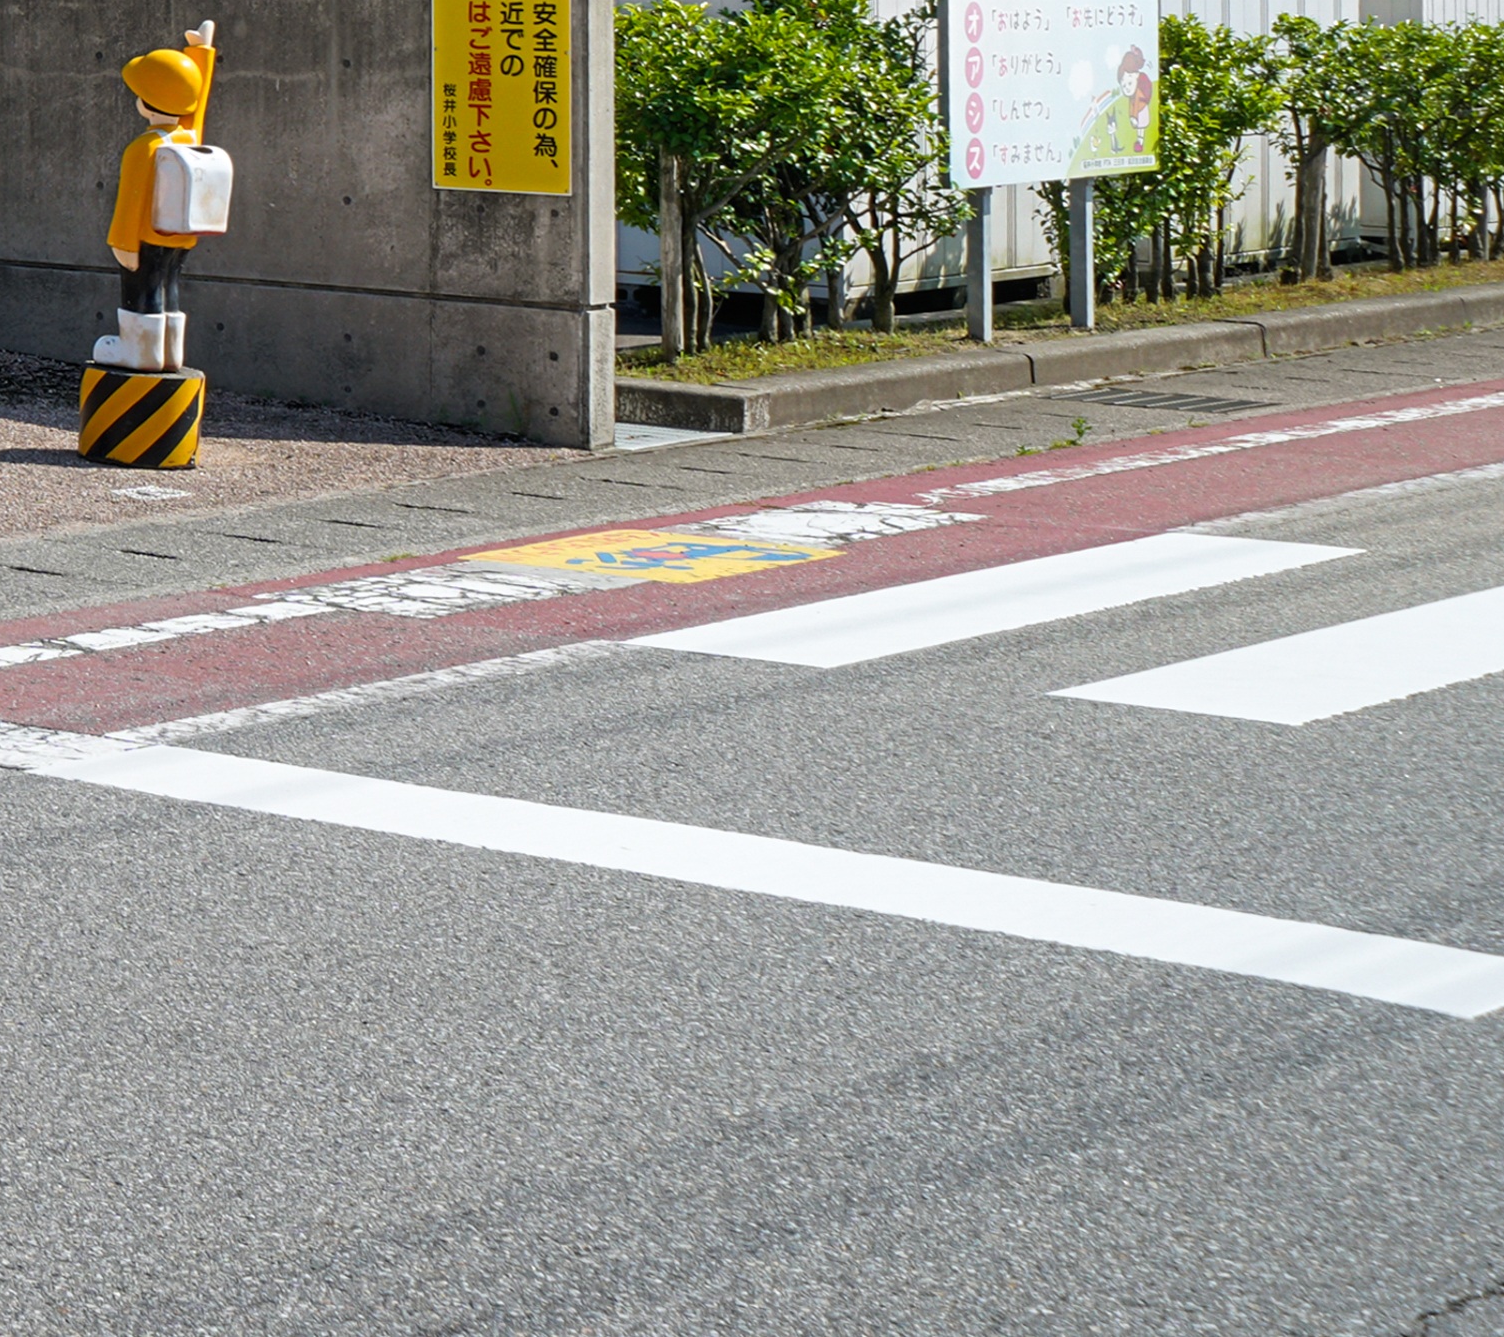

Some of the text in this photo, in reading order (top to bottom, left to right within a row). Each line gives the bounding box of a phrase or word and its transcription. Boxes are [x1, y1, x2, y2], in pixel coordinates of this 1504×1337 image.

[442, 83, 457, 176] 桜井小学校長
